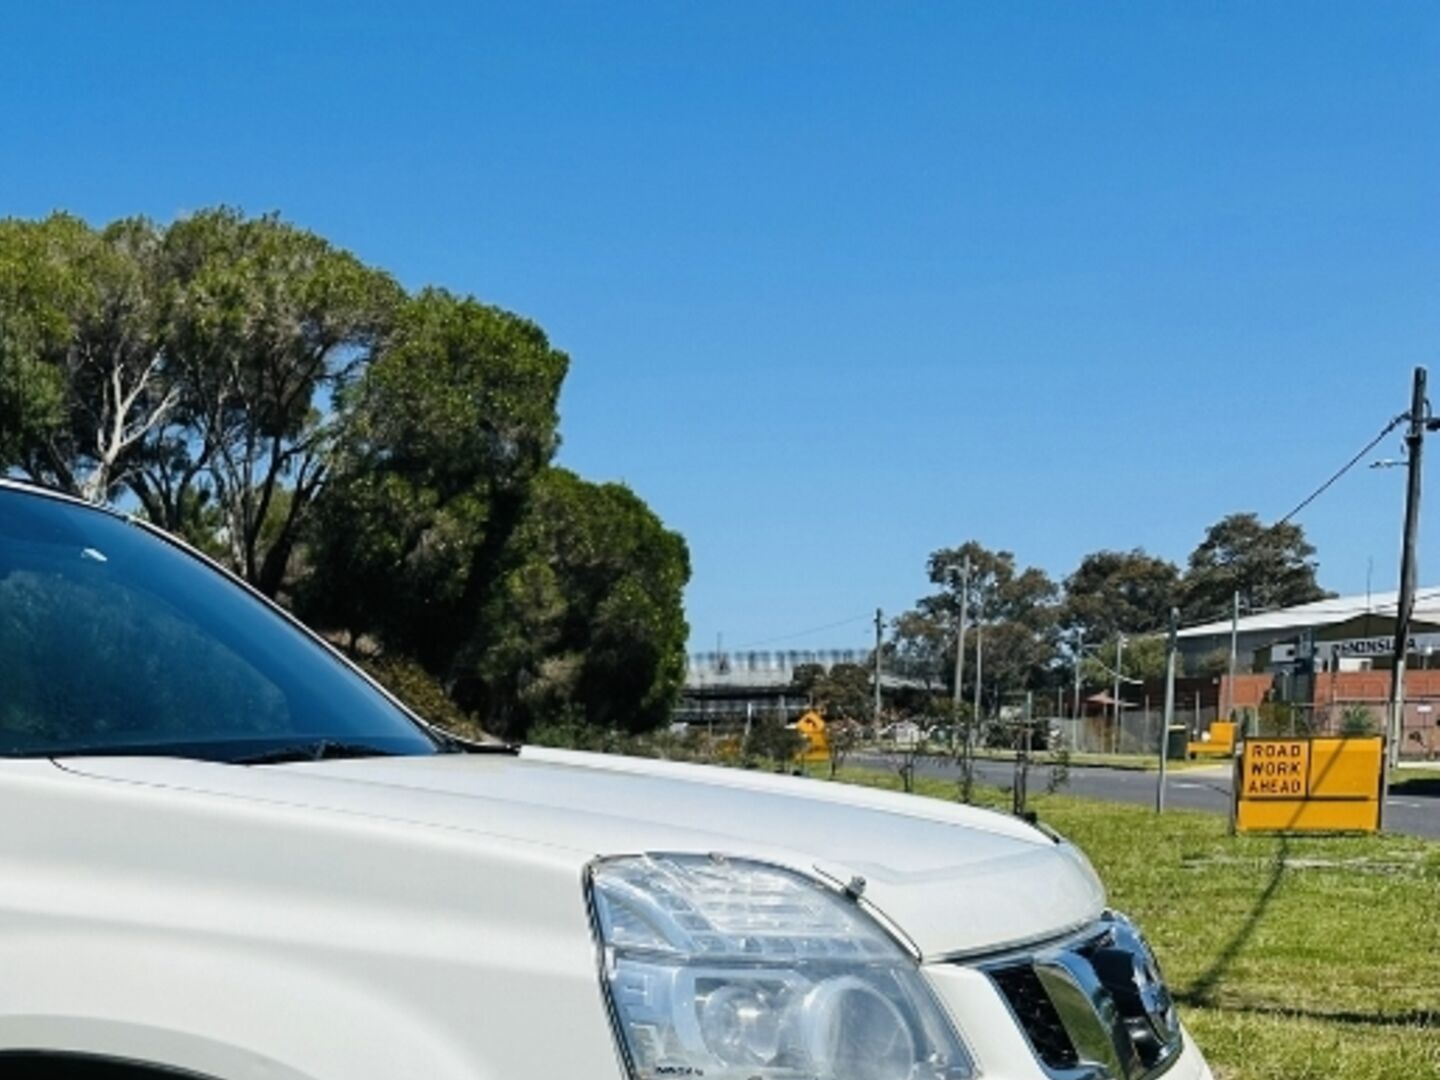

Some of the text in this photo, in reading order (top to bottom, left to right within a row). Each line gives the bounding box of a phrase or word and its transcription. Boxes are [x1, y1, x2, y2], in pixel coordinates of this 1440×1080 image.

[1331, 637, 1415, 654] PENINSUA
[1252, 745, 1301, 757] ROAD
[1252, 761, 1301, 776] WORK
[1249, 780, 1301, 793] AHEAD
